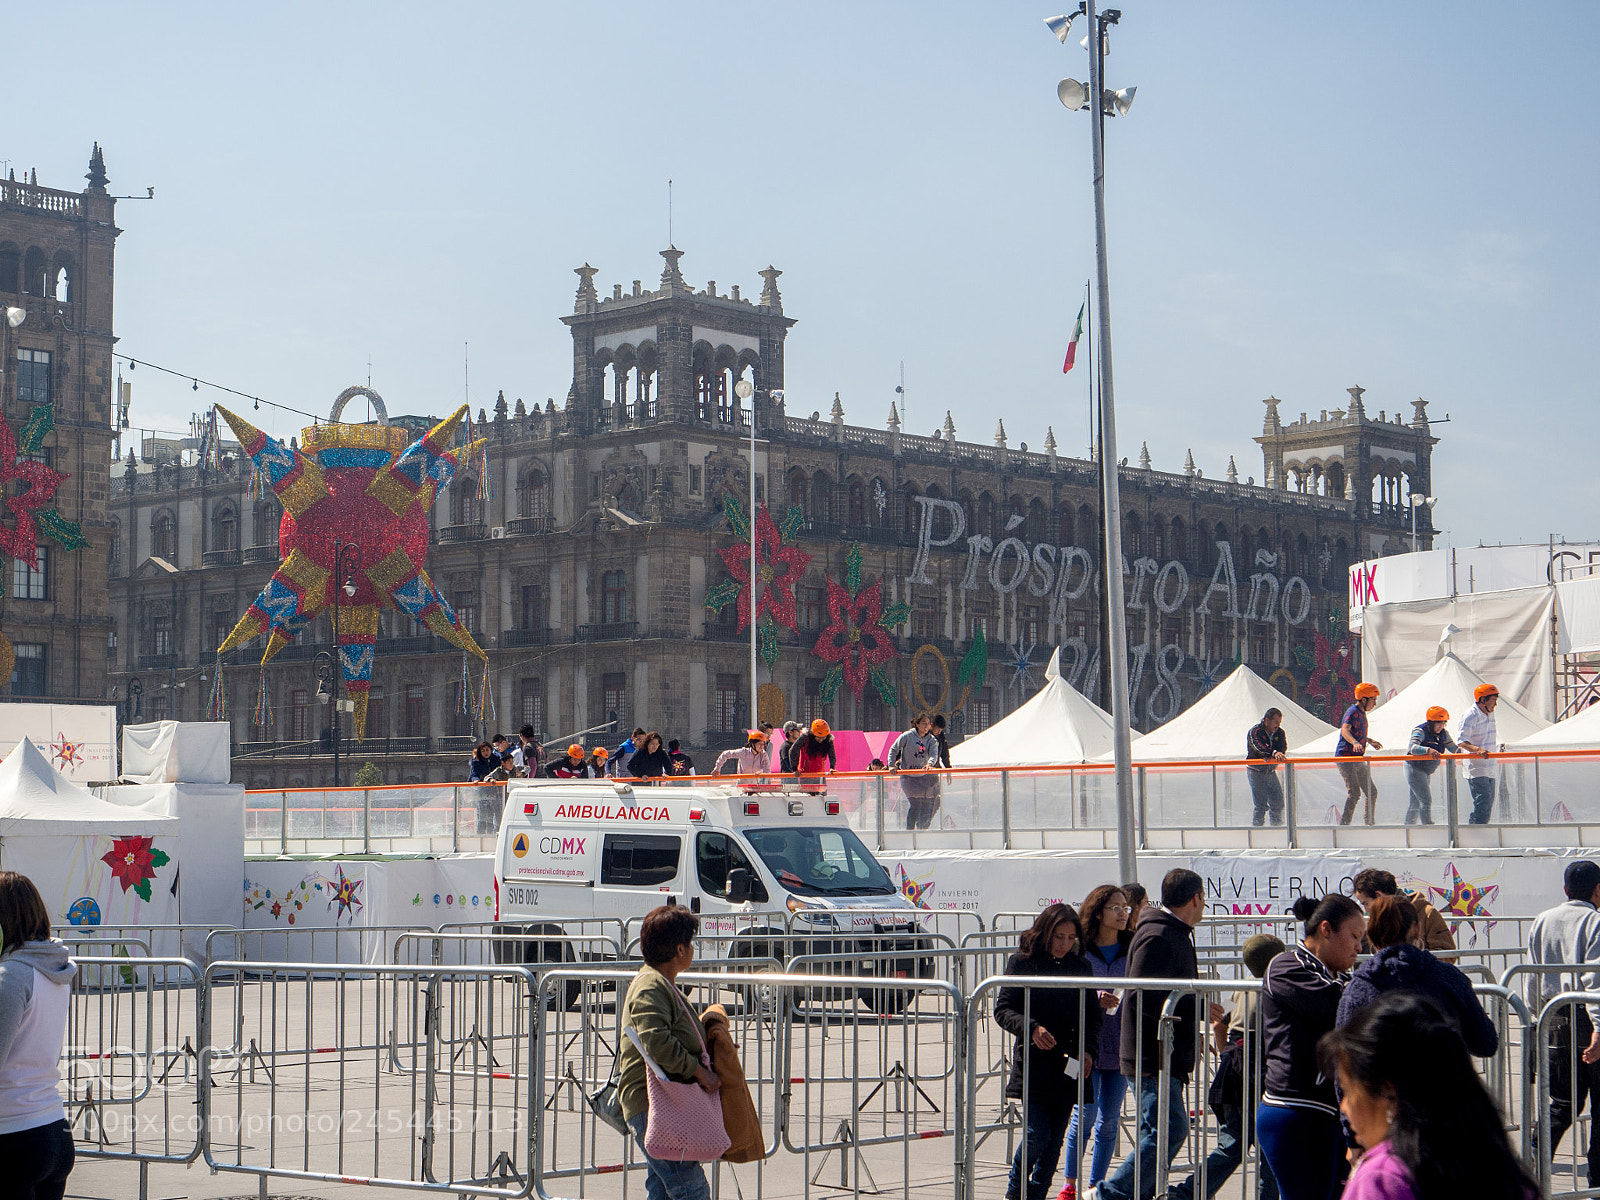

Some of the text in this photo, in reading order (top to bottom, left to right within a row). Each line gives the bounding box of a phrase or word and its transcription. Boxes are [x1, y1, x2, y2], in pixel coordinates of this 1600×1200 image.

[904, 495, 1312, 626] Próspro Año
[1351, 564, 1379, 608] MX
[1060, 636, 1184, 725] 218
[555, 804, 670, 821] AMBULANCIA
[539, 836, 586, 855] CDMX
[508, 887, 539, 906] SVB 002
[1207, 876, 1355, 899] NVIERNO
[938, 902, 979, 910] CDMX 2017
